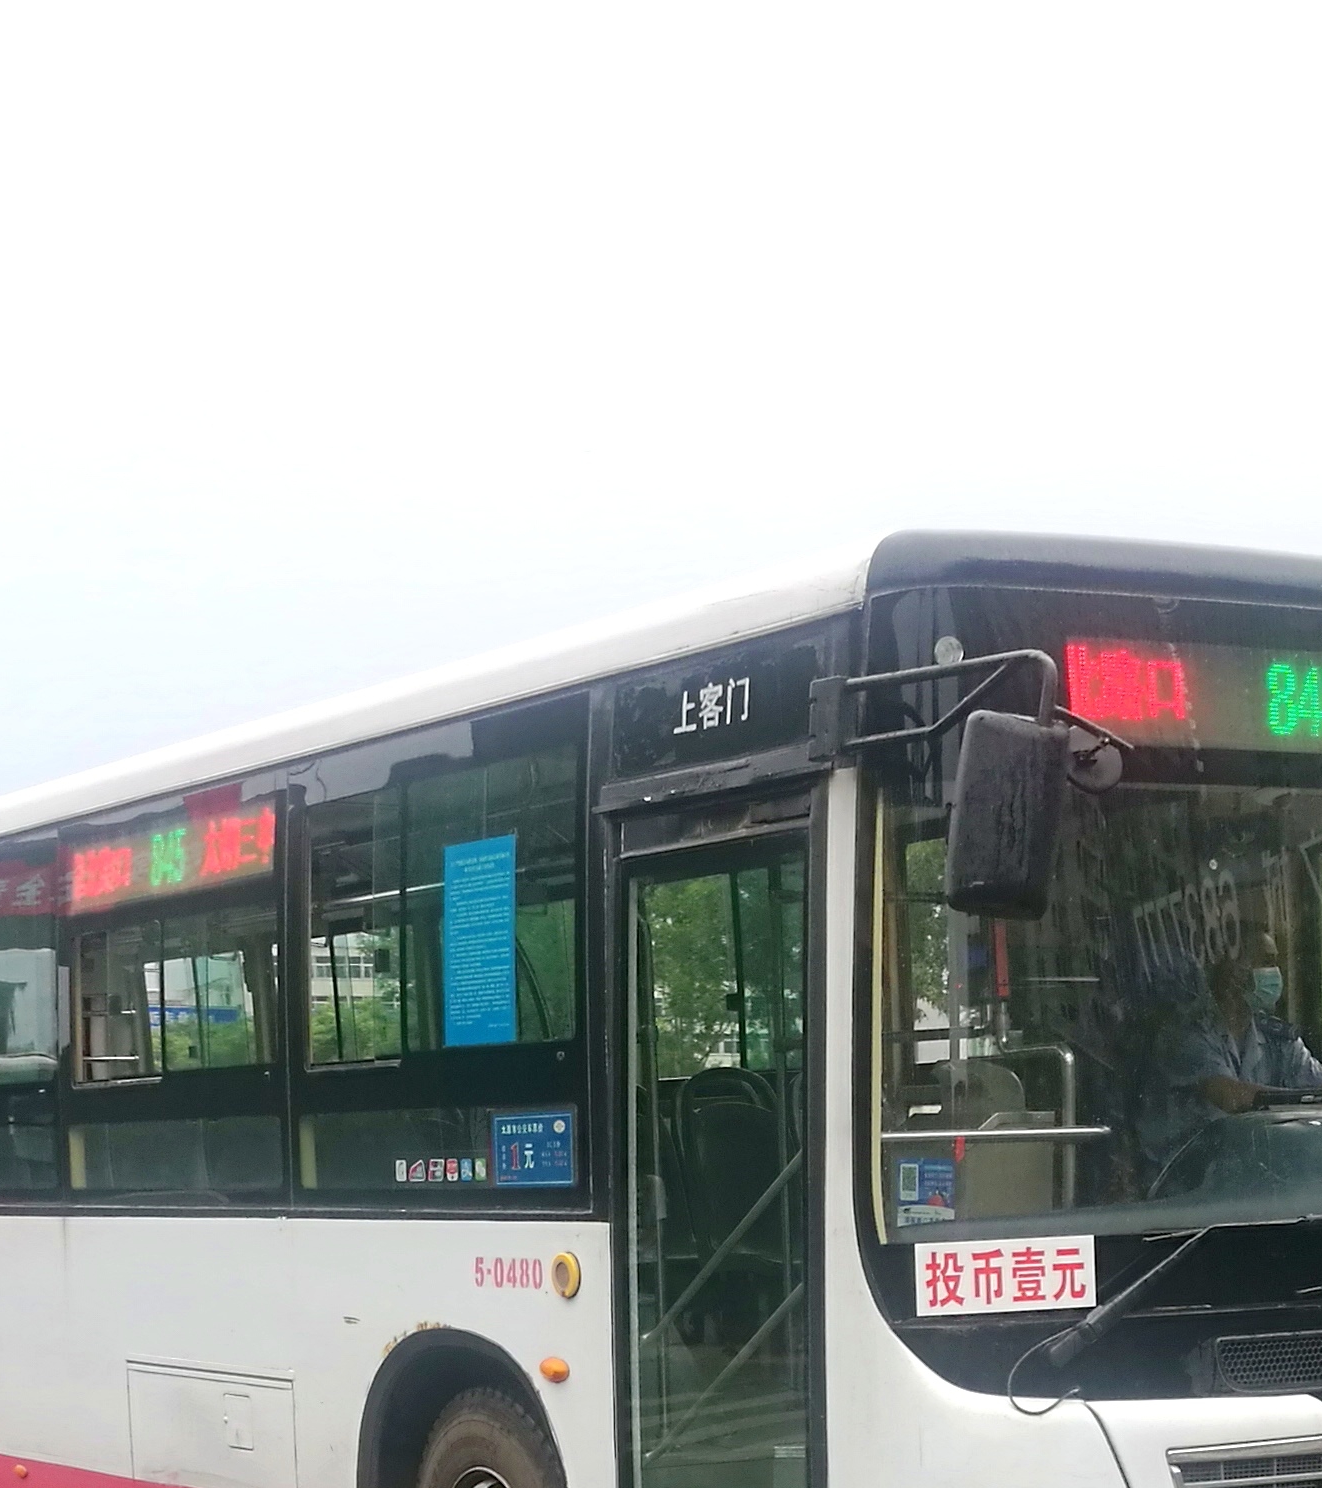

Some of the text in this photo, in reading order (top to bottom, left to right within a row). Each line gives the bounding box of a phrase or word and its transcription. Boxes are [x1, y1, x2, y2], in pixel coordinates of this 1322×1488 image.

[673, 677, 750, 735] 上客门
[925, 1247, 1086, 1308] 投币壹元
